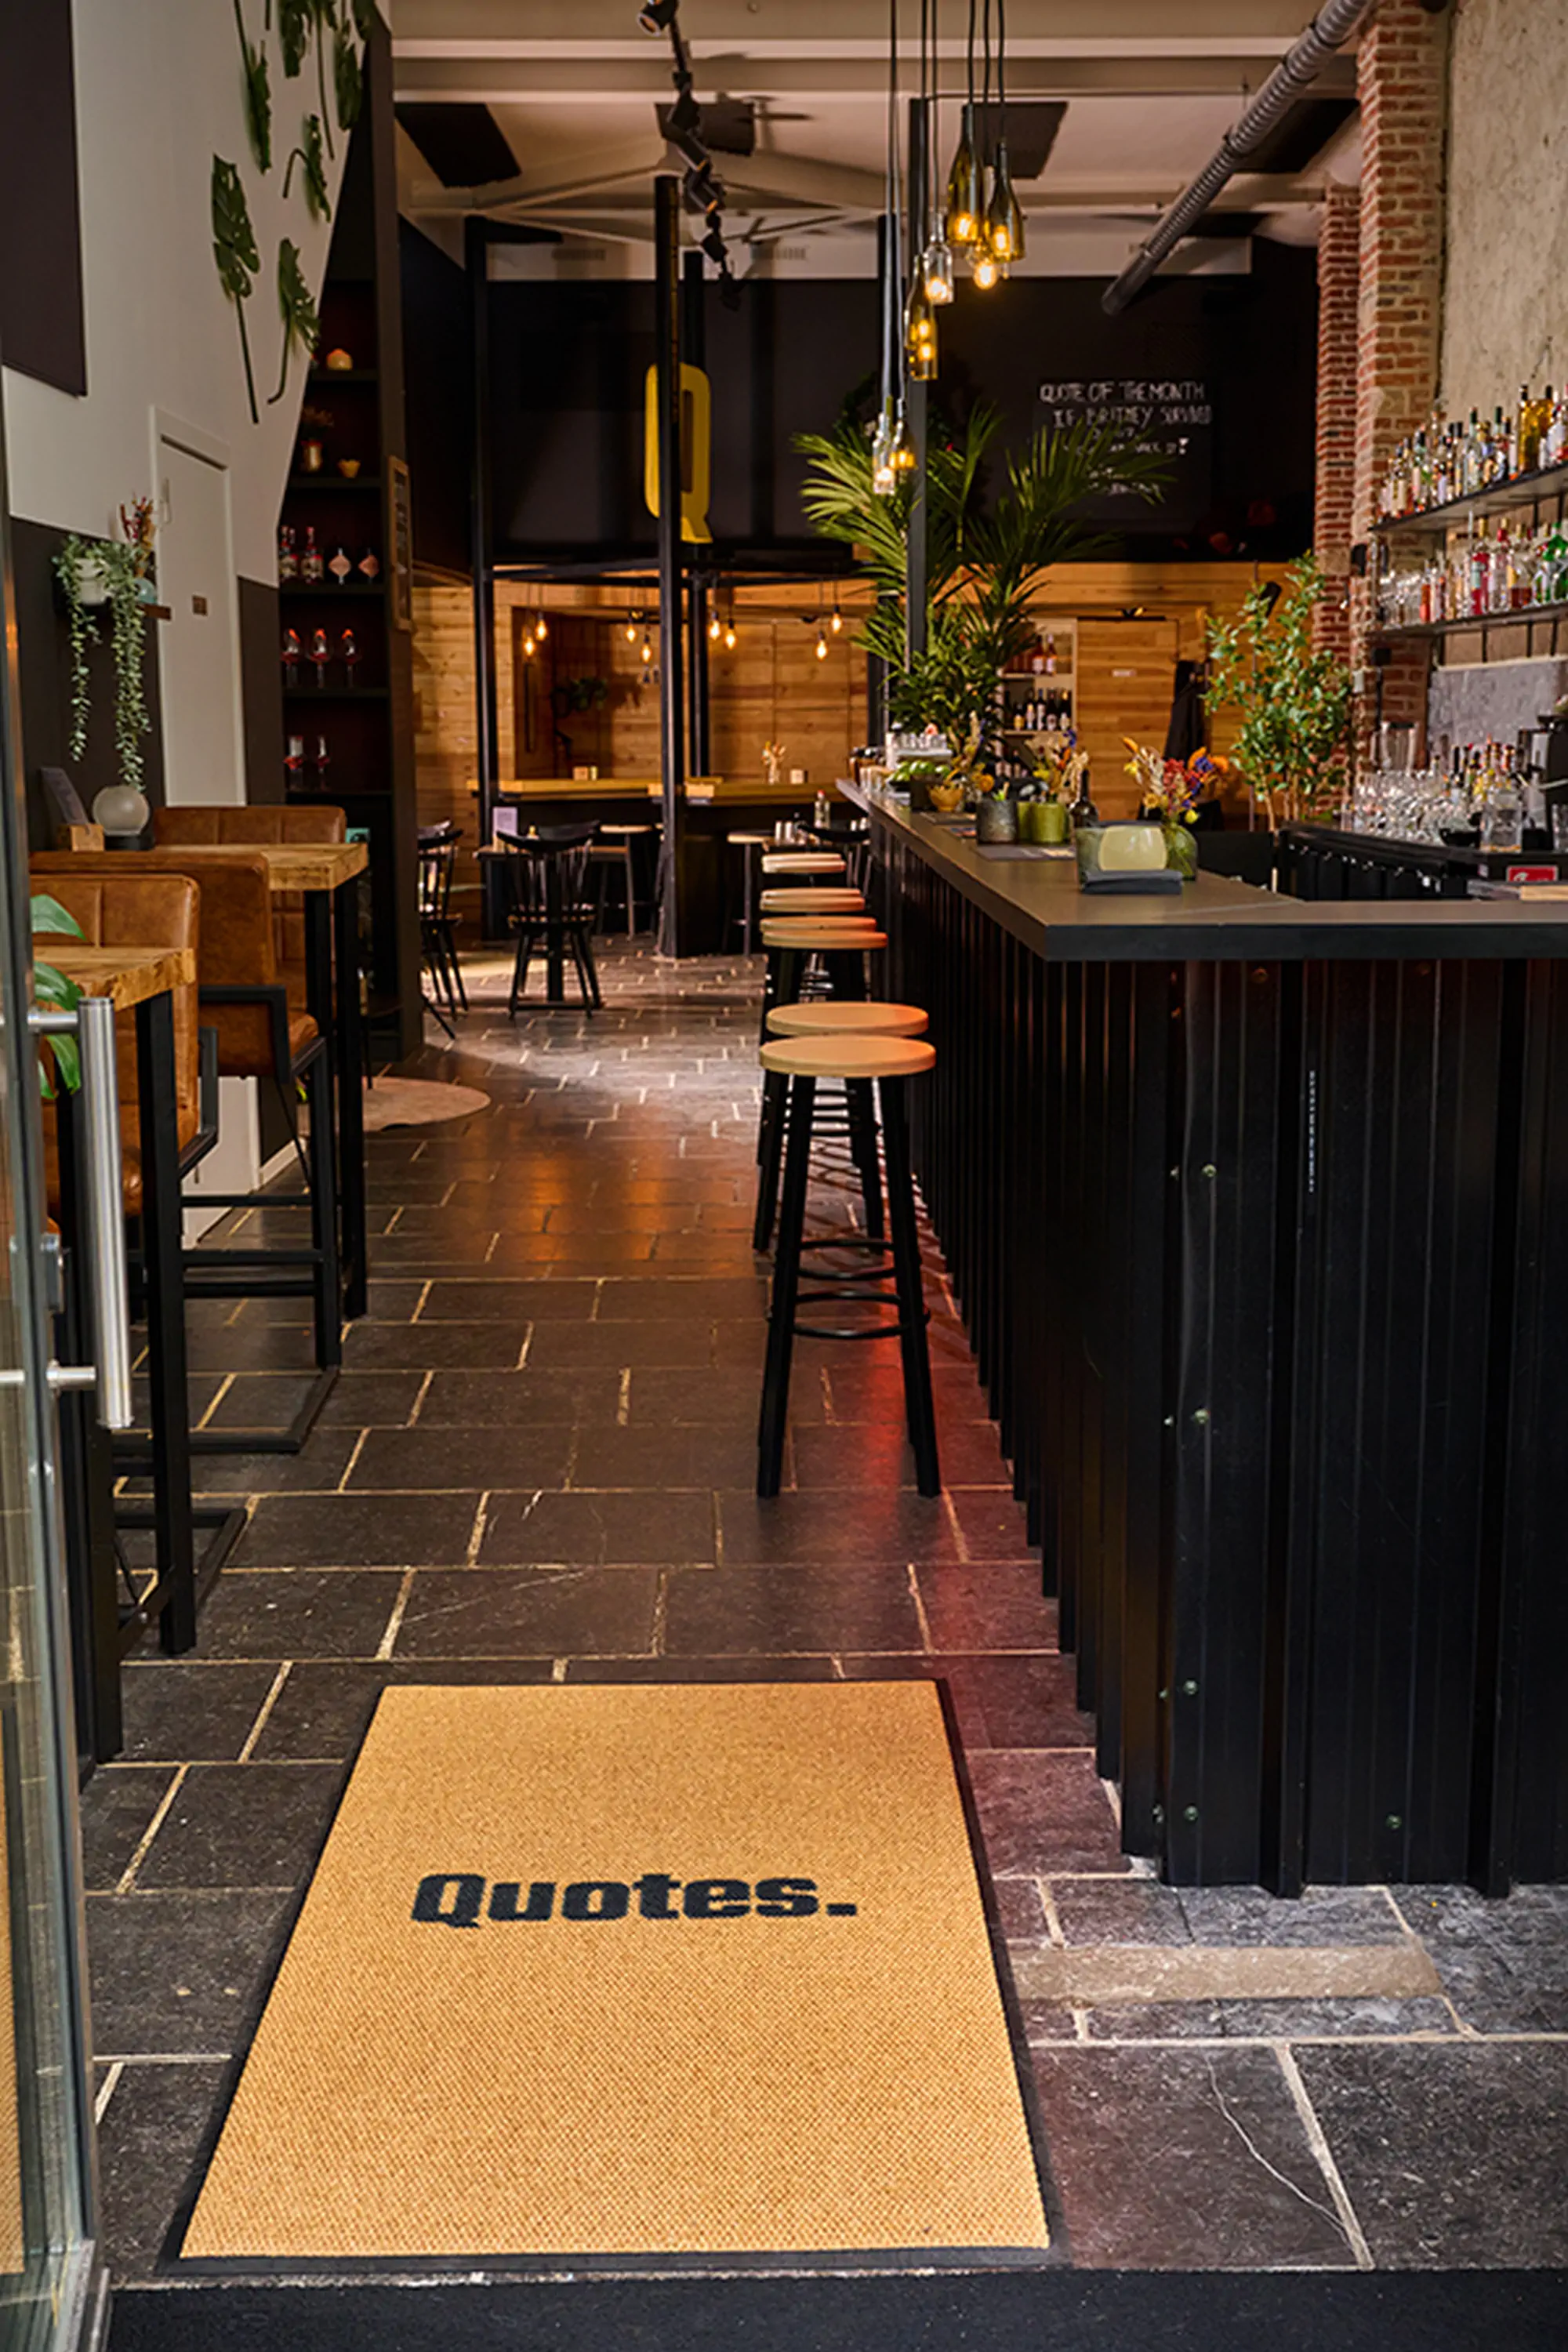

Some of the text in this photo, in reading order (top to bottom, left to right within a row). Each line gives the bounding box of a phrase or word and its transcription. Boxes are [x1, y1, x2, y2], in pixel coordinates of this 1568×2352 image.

[1087, 381, 1115, 403] OF
[644, 361, 713, 543] Q
[411, 1873, 858, 1929] Quotes.
